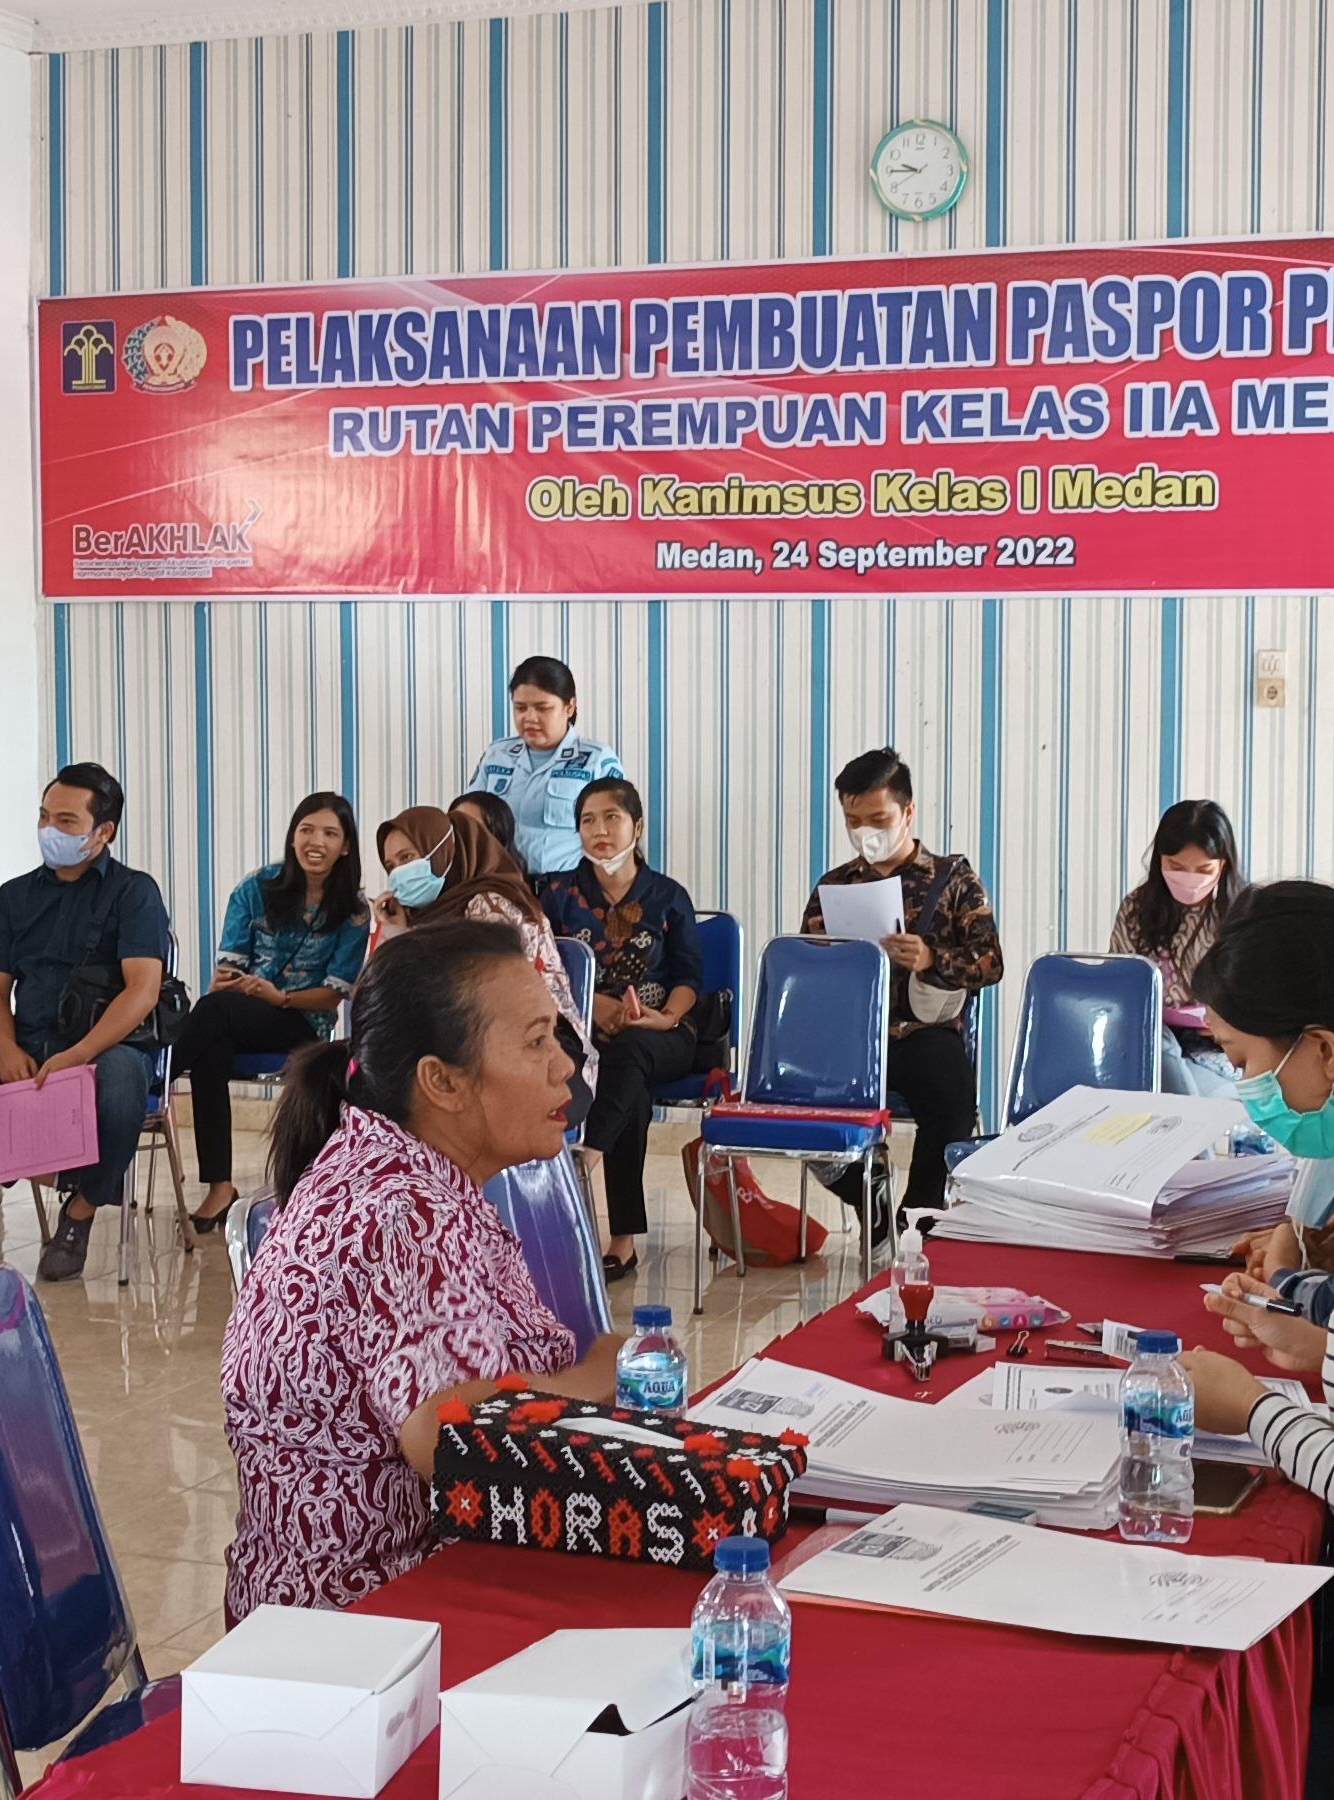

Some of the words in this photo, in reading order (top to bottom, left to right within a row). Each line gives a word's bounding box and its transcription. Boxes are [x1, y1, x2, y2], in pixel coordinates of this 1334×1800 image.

[229, 301, 621, 391] PELAKSANAAN
[630, 282, 997, 379] PEMBUATAN
[1007, 270, 1272, 366] PASPOR
[328, 403, 513, 458] RUTAN
[527, 391, 887, 453] PEREMPUAN
[901, 383, 1109, 443] KELAS
[1124, 380, 1219, 436] IIA
[528, 476, 629, 520] Oleh
[639, 470, 863, 519] Kanimsus
[872, 465, 1009, 515] Kelas
[1017, 465, 1037, 514] I
[1047, 463, 1218, 511] Medan
[73, 522, 253, 555] BerAKHLAK
[655, 541, 763, 575] Medan,
[771, 540, 809, 570] 24
[817, 537, 987, 577] September
[995, 536, 1076, 567] 2022
[643, 1381, 675, 1393] AQUA
[490, 1485, 685, 1564] HORAS
